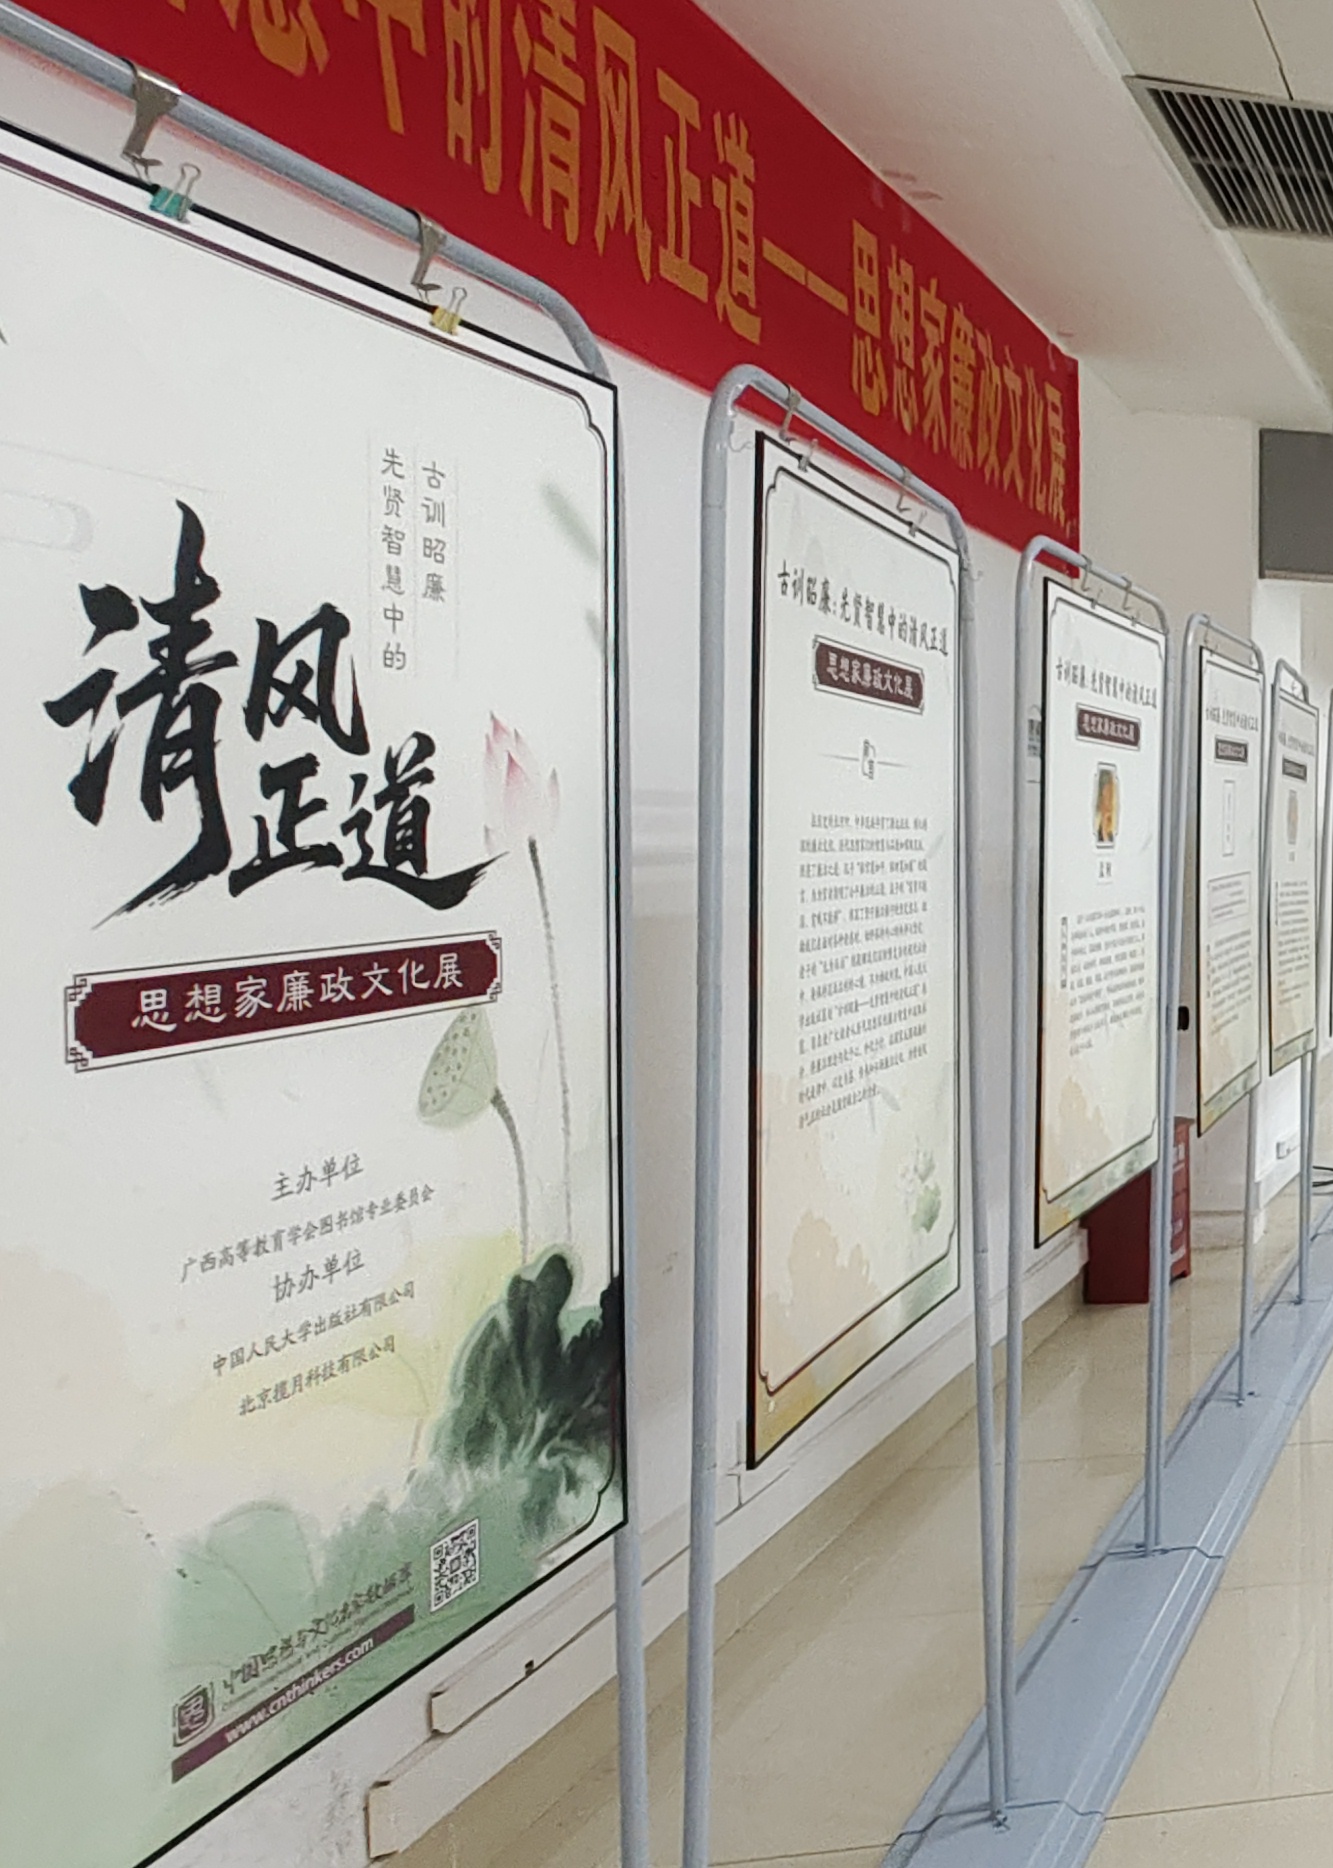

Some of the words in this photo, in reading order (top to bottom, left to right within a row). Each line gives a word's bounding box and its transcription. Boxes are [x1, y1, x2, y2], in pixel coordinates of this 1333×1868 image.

[381, 447, 407, 671] 先贤智慧中的
[421, 461, 447, 602] 古训昭廉
[131, 953, 464, 1033] 思想家廉政文化展
[270, 1152, 365, 1201] 主办单位
[272, 1248, 365, 1303] 协办单位
[212, 1281, 416, 1376] 中国人民大学出版社有限公司
[226, 1637, 374, 1743] www.cnthinkers.com
